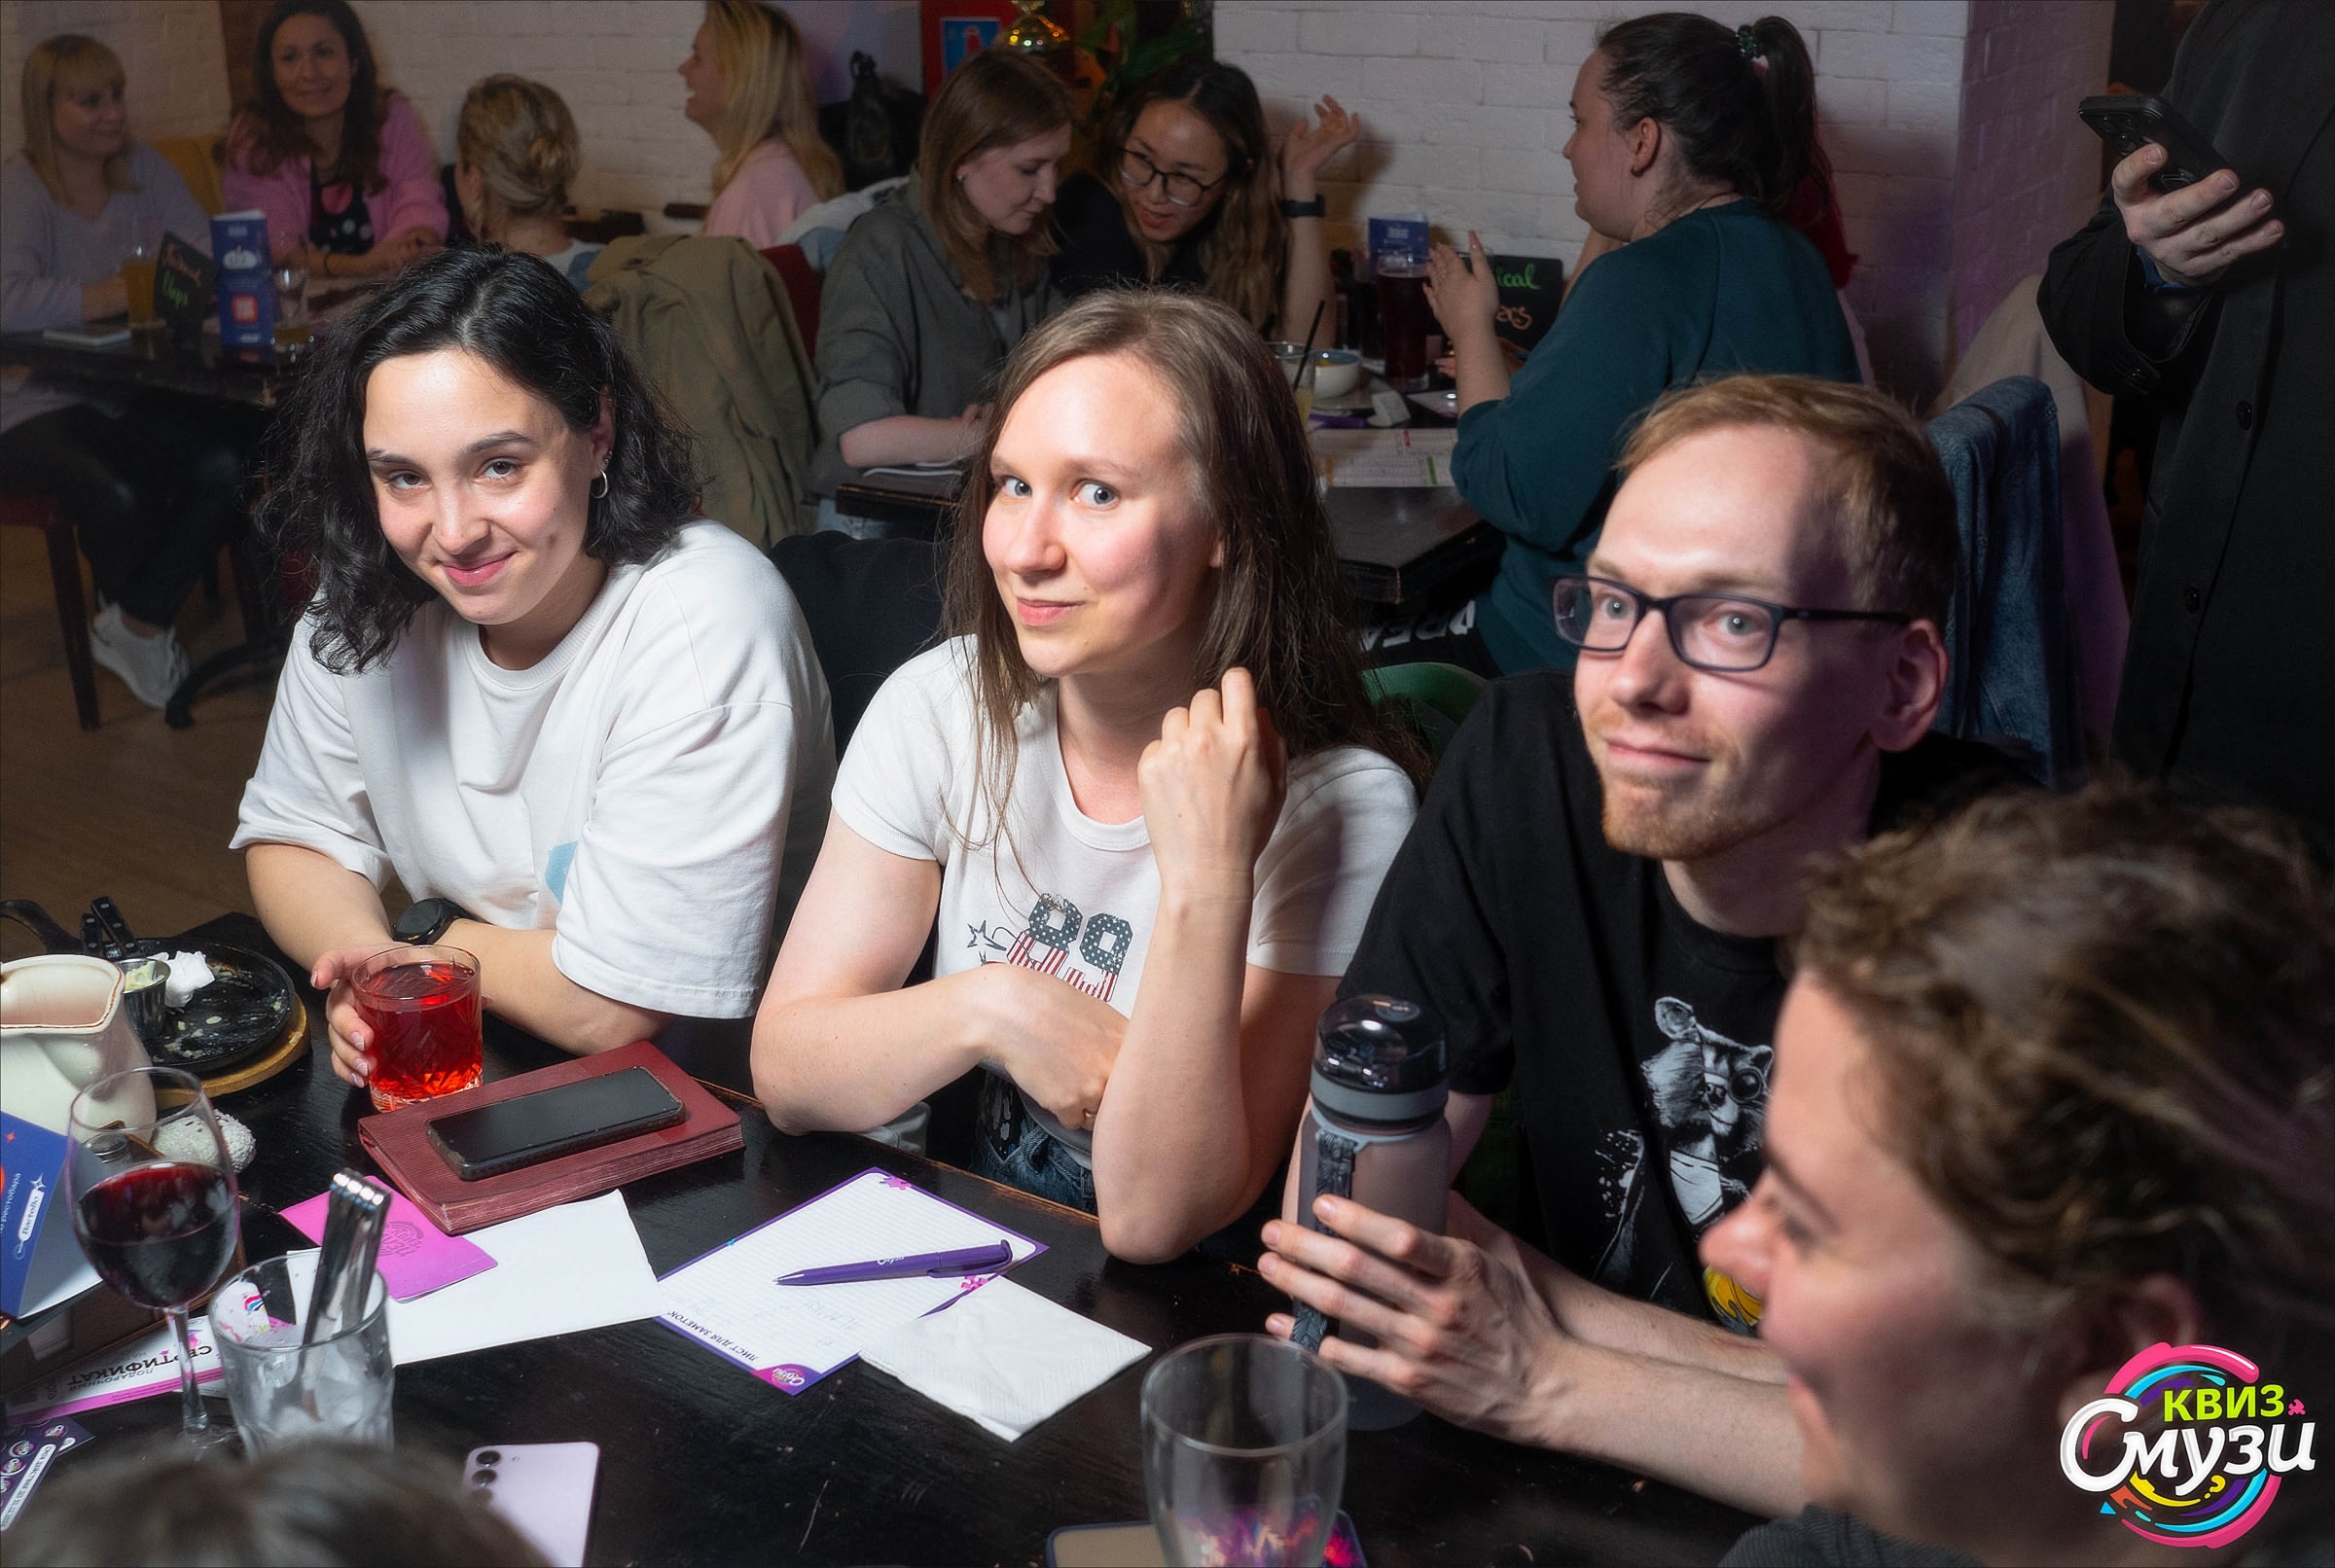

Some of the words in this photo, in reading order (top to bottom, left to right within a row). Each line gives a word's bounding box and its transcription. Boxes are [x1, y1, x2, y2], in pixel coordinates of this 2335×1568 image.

[1006, 892, 1133, 1002] 89
[710, 1334, 732, 1347] ДЛЯ
[732, 1344, 761, 1362] ЛИСТ
